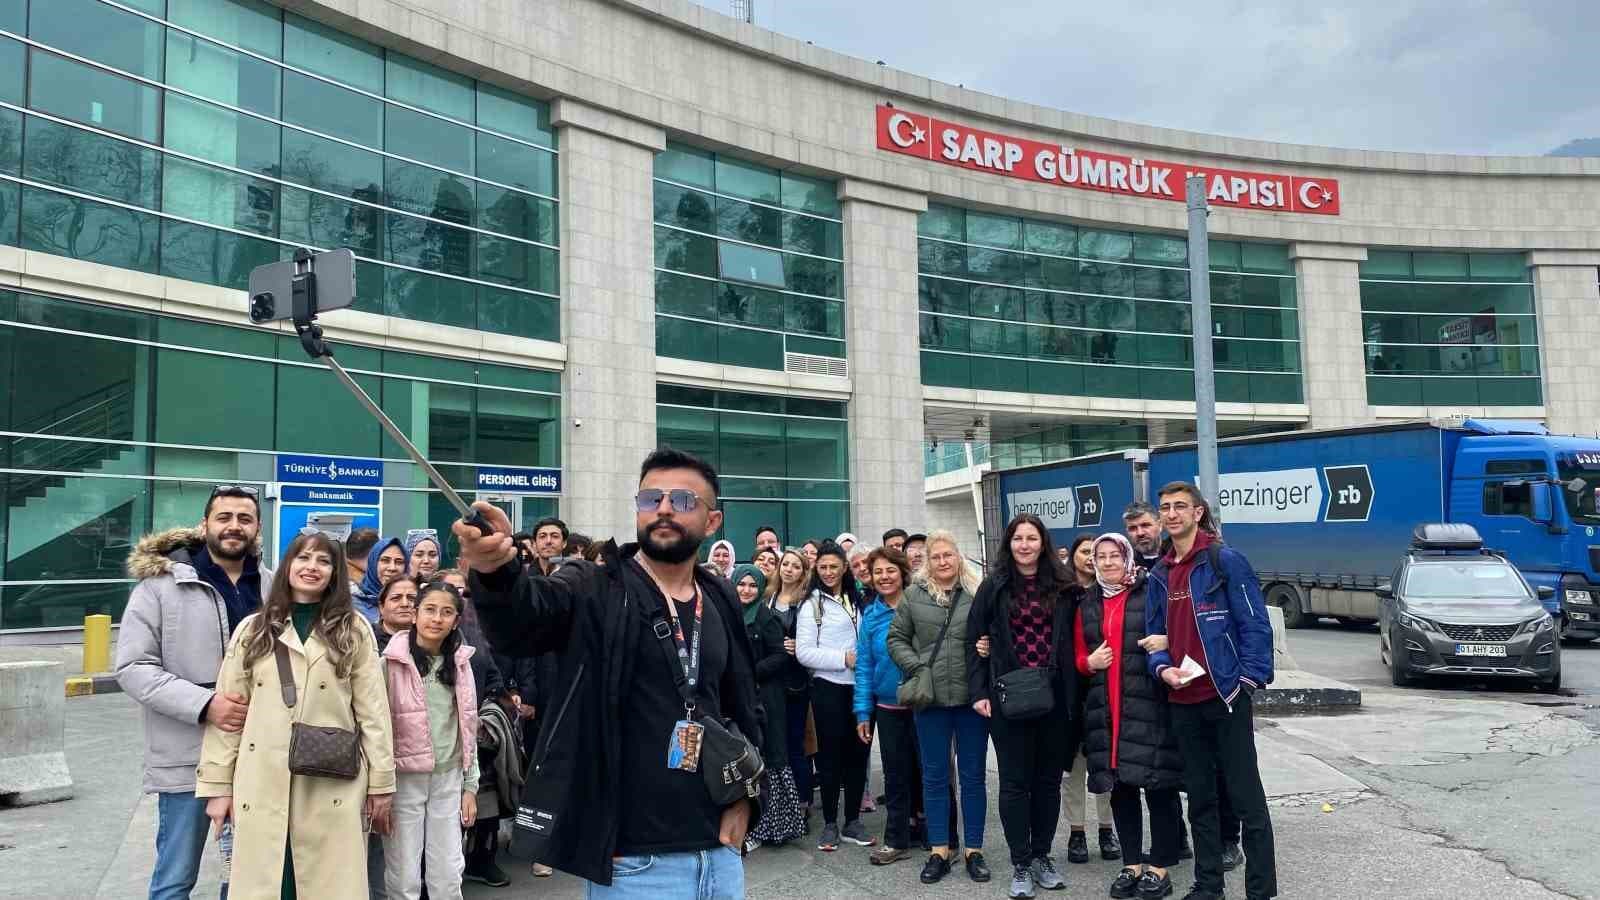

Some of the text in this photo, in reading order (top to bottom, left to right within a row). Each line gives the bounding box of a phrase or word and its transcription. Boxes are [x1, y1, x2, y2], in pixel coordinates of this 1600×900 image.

[942, 129, 1285, 208] SARP GÜMRÜK APISI
[284, 463, 380, 478] TÜRKİYE BANKASI
[479, 473, 558, 490] PERSONEL GİRİŞ
[308, 490, 354, 501] Bankamatik
[1219, 482, 1361, 510] enzinger rb
[1083, 499, 1097, 514] rb
[1489, 646, 1505, 655] 203
